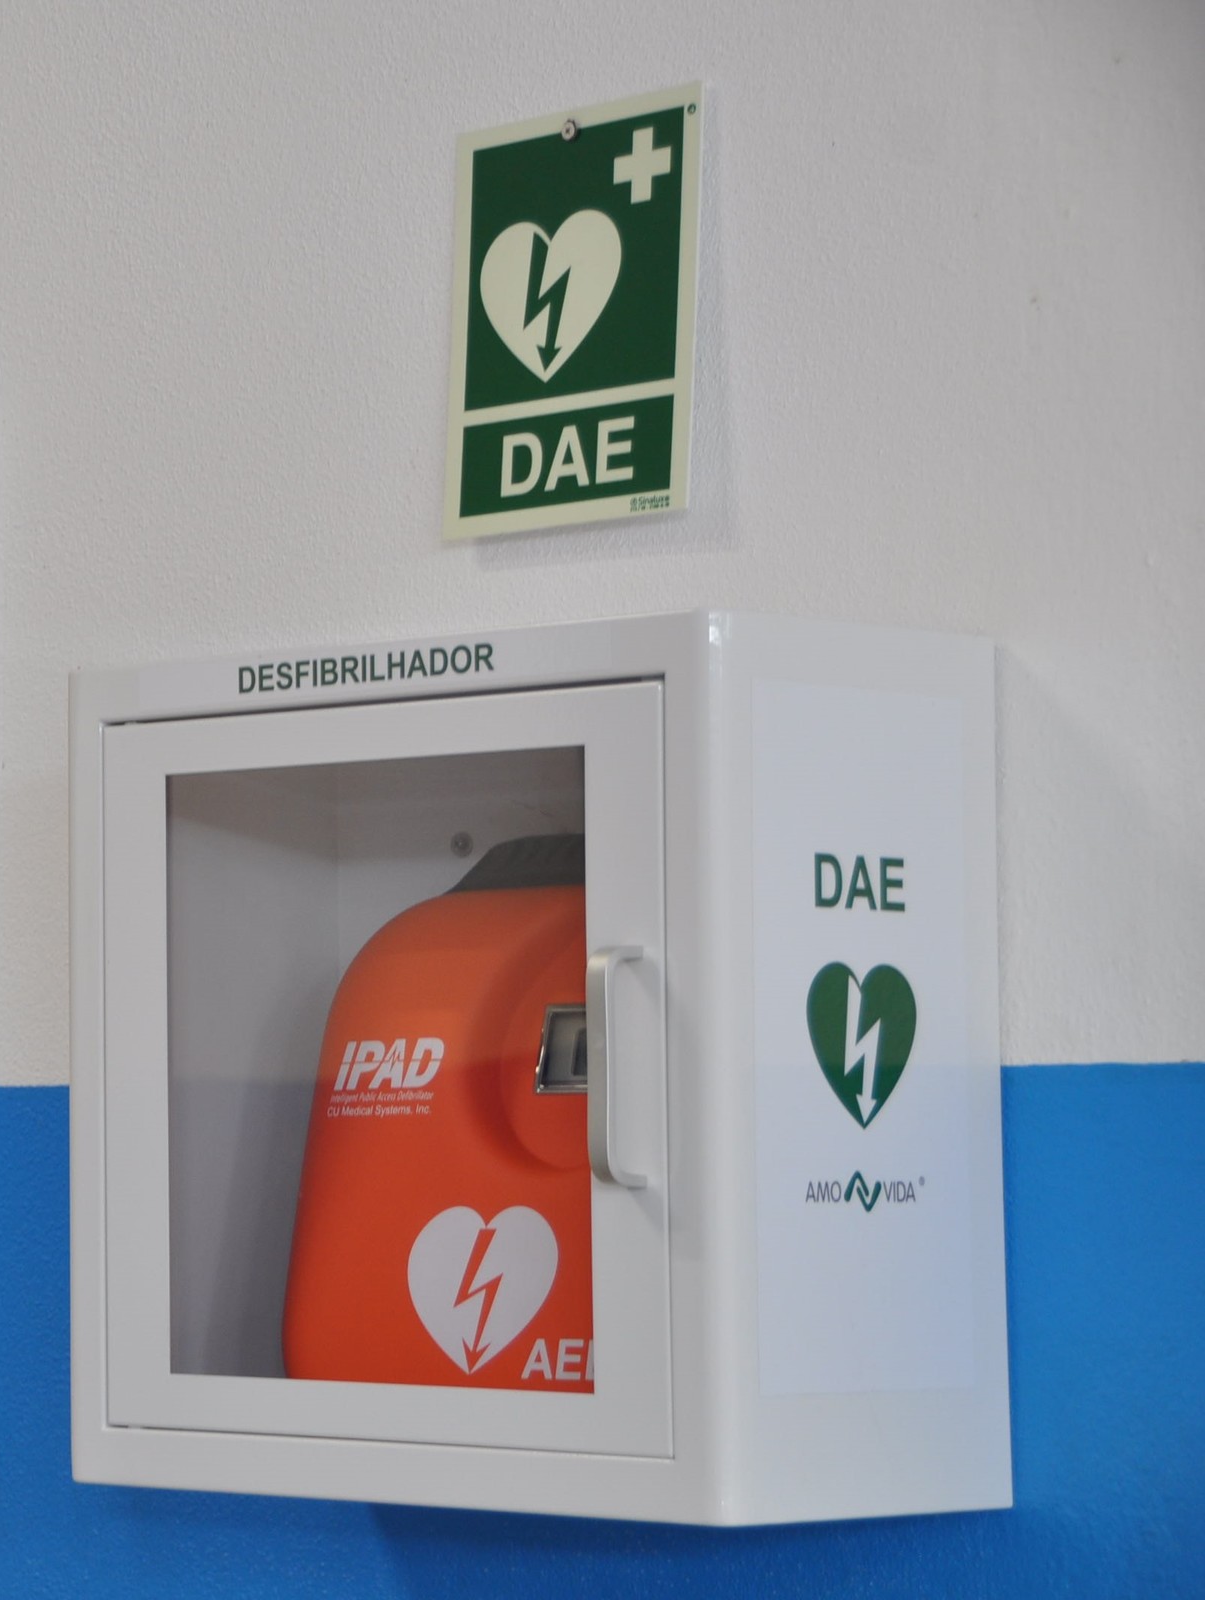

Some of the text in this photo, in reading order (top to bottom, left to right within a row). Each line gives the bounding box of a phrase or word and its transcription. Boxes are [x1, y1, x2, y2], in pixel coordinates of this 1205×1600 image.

[500, 415, 635, 498] DAE
[238, 643, 494, 694] DESFIBRILHADOR
[814, 852, 906, 912] DAE
[333, 1036, 445, 1092] IPAD
[327, 1106, 340, 1117] CU
[341, 1105, 373, 1116] Medical
[358, 1092, 376, 1102] Public
[377, 1091, 396, 1101] Access
[805, 1180, 916, 1203] AMO VIDA
